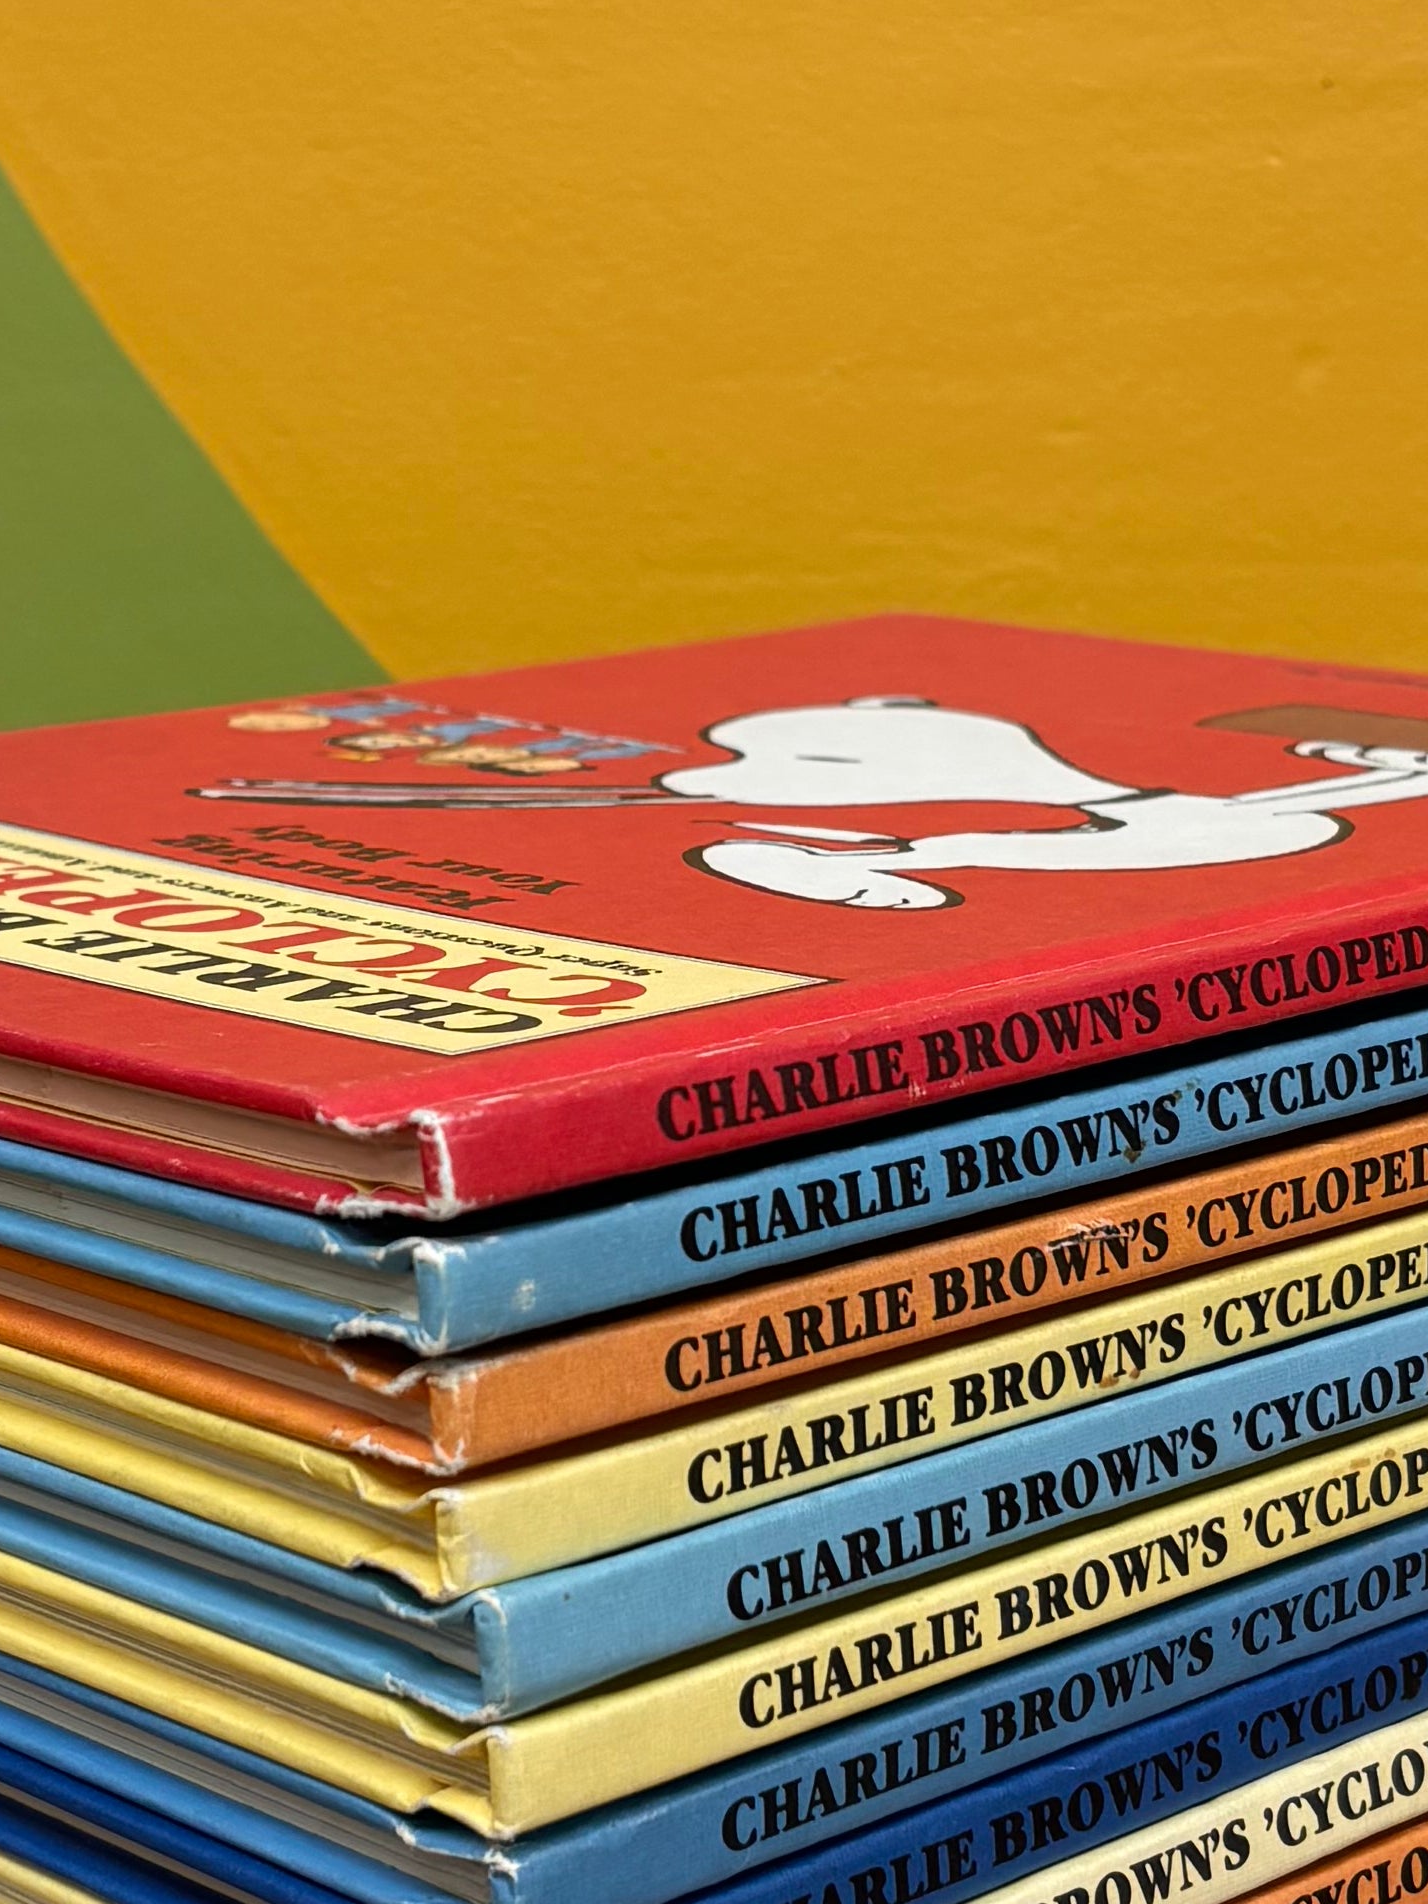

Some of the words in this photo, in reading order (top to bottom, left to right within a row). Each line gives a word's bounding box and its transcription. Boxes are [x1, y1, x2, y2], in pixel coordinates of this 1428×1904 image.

[87, 864, 162, 879] and
[152, 834, 515, 909] Featuring
[160, 878, 300, 908] Answers
[234, 826, 416, 863] Body
[407, 859, 580, 895] Your
[288, 906, 366, 921] and
[364, 920, 546, 956] Questions
[540, 953, 662, 976] Super
[23, 930, 542, 1033] CHARLIE
[657, 1040, 908, 1141] CHARLIE
[919, 984, 1160, 1082] BROWN'S
[680, 1156, 929, 1261] CHARLIE
[941, 1090, 1181, 1197] BROWN'S
[665, 1279, 915, 1391] CHARLIE
[687, 1387, 934, 1503] CHARLIE
[950, 1313, 1185, 1425] BROWN'S
[727, 1497, 969, 1620] CHARLIE
[983, 1419, 1216, 1536] BROWN'S
[739, 1601, 981, 1728] CHARLIE
[995, 1517, 1227, 1639] BROWN'S
[722, 1718, 965, 1851] CHARLIE
[981, 1627, 1213, 1753] BROWN'S
[990, 1731, 1221, 1865] BROWN'S
